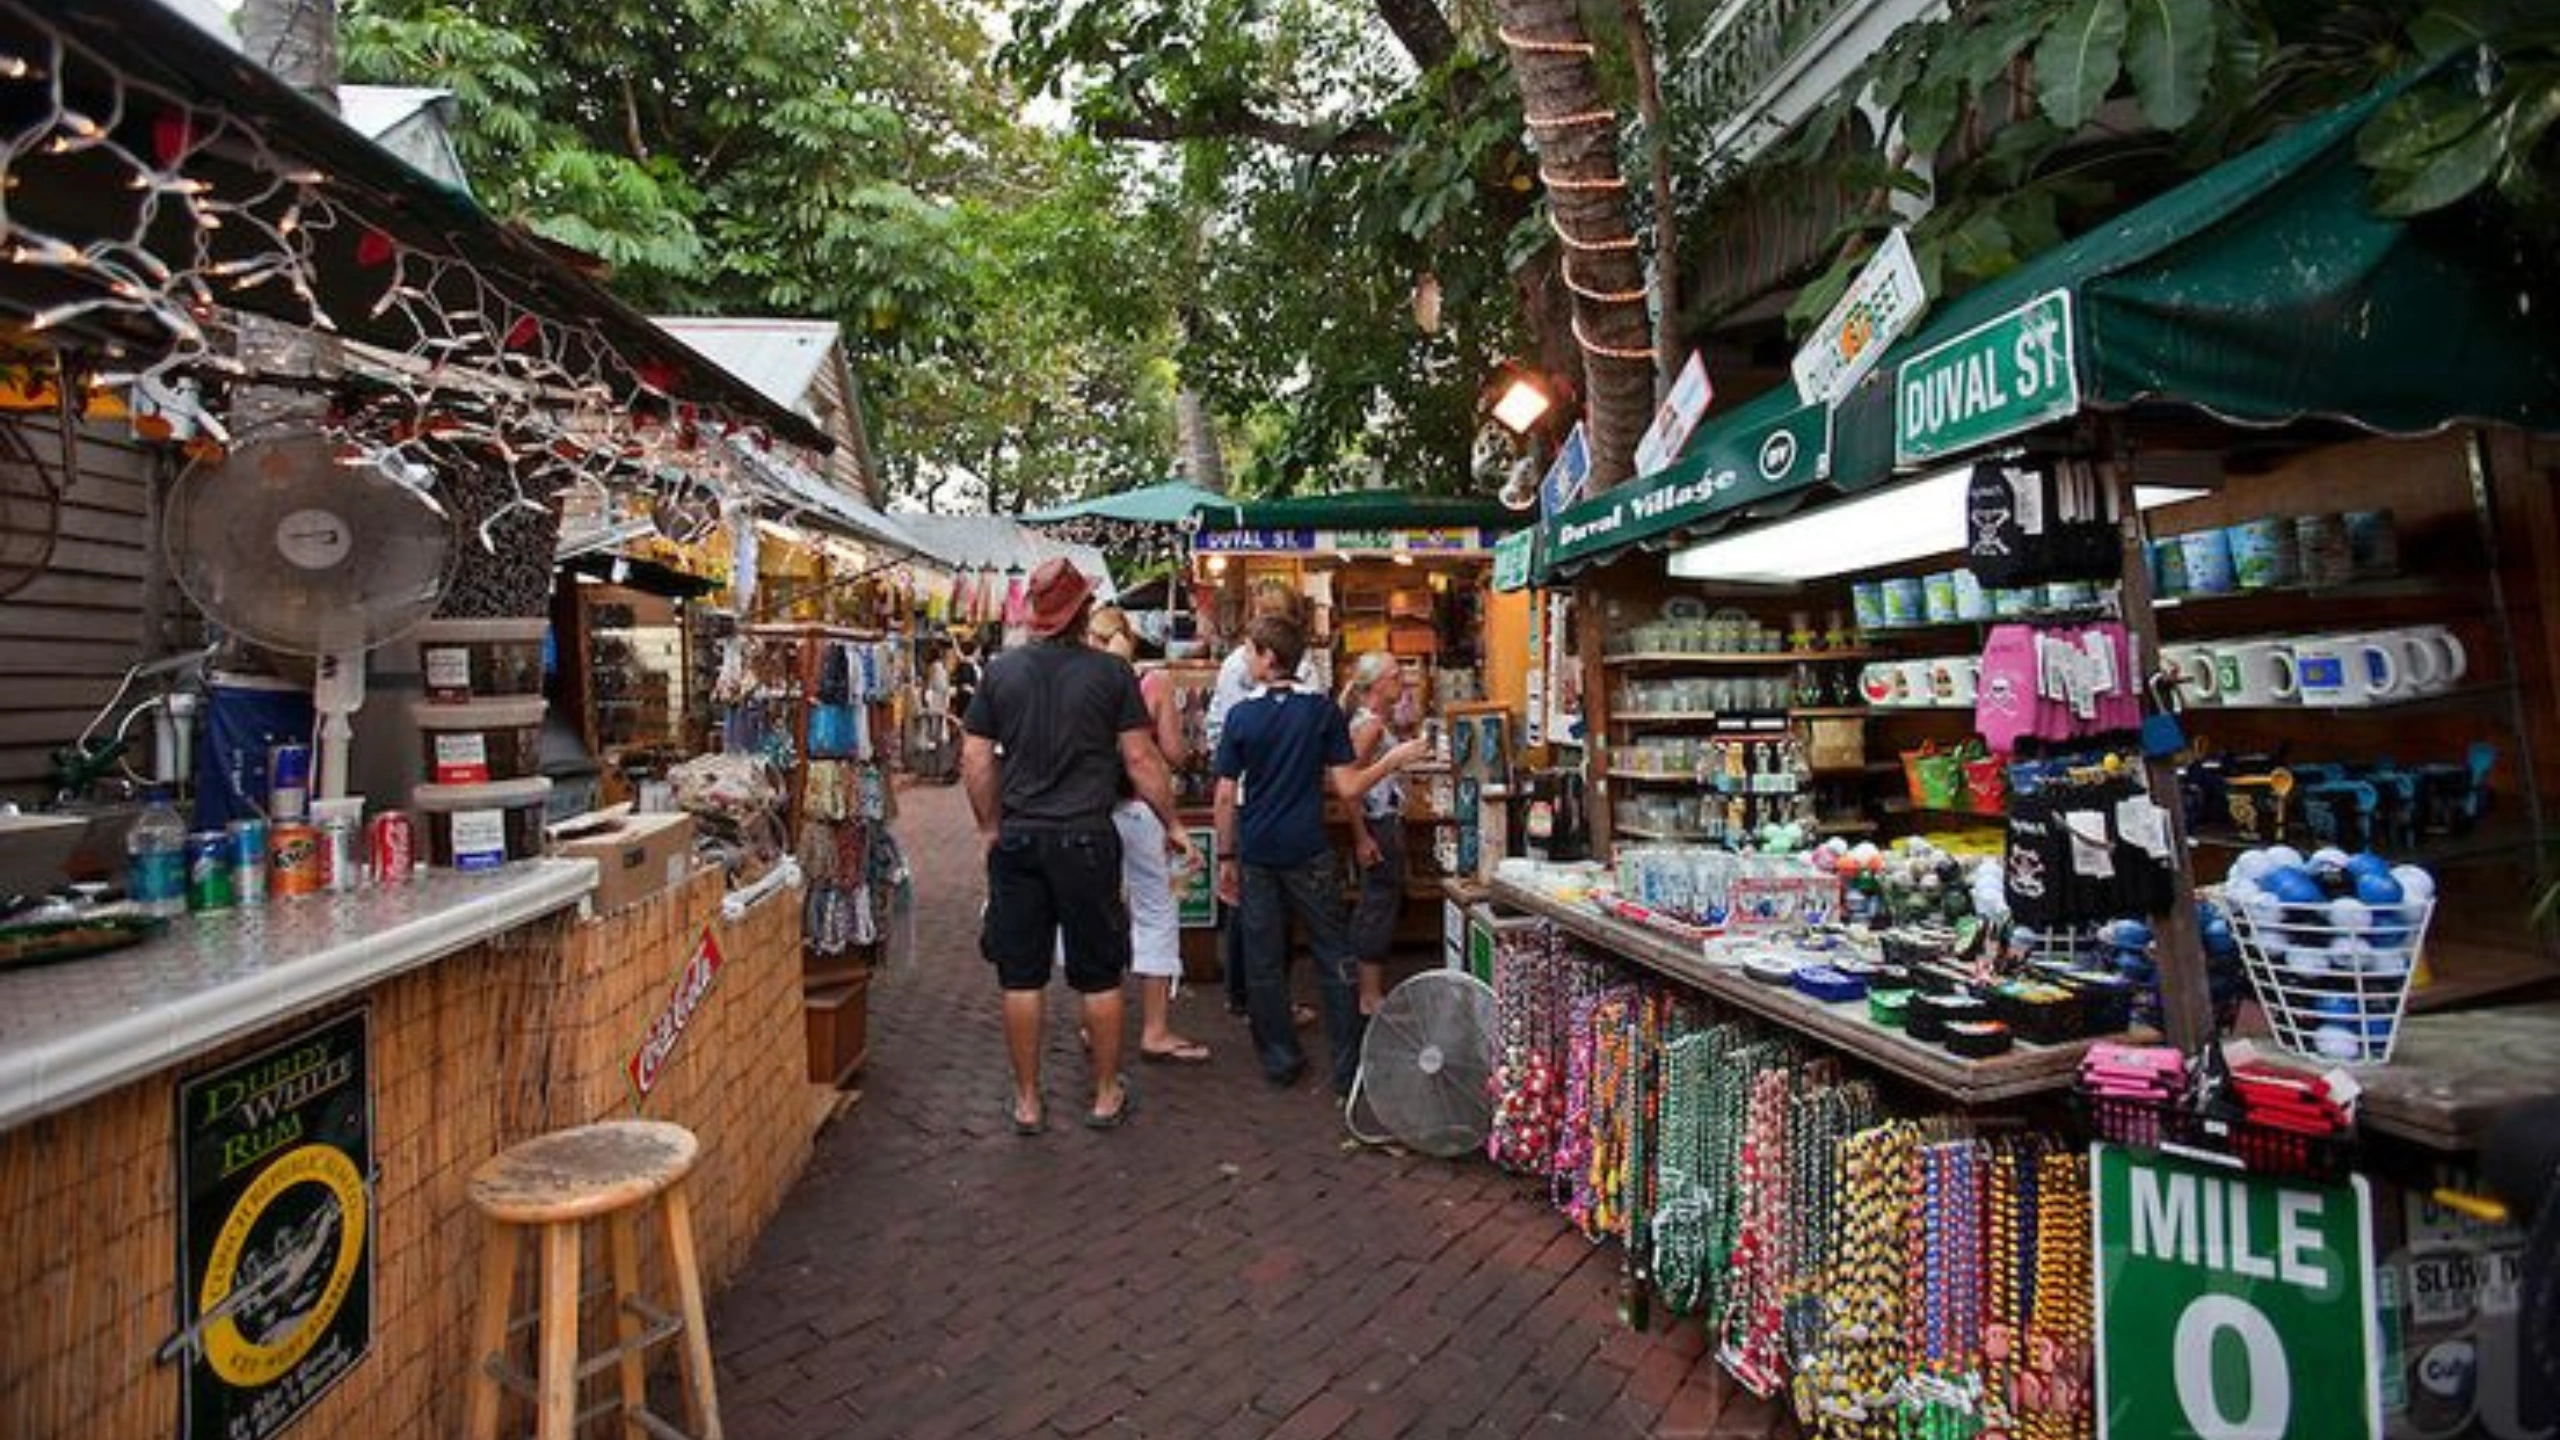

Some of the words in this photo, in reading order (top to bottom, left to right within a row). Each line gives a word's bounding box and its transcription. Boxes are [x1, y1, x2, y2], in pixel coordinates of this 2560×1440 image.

[1906, 347, 2007, 440] DUVAL
[2015, 319, 2059, 397] ST
[1560, 505, 1622, 545] Duval
[1631, 468, 1738, 521] Village
[242, 1052, 352, 1130] WHITE
[224, 1112, 304, 1172] RUM
[2129, 1166, 2328, 1290] MILE
[2173, 1292, 2292, 1440] 0
